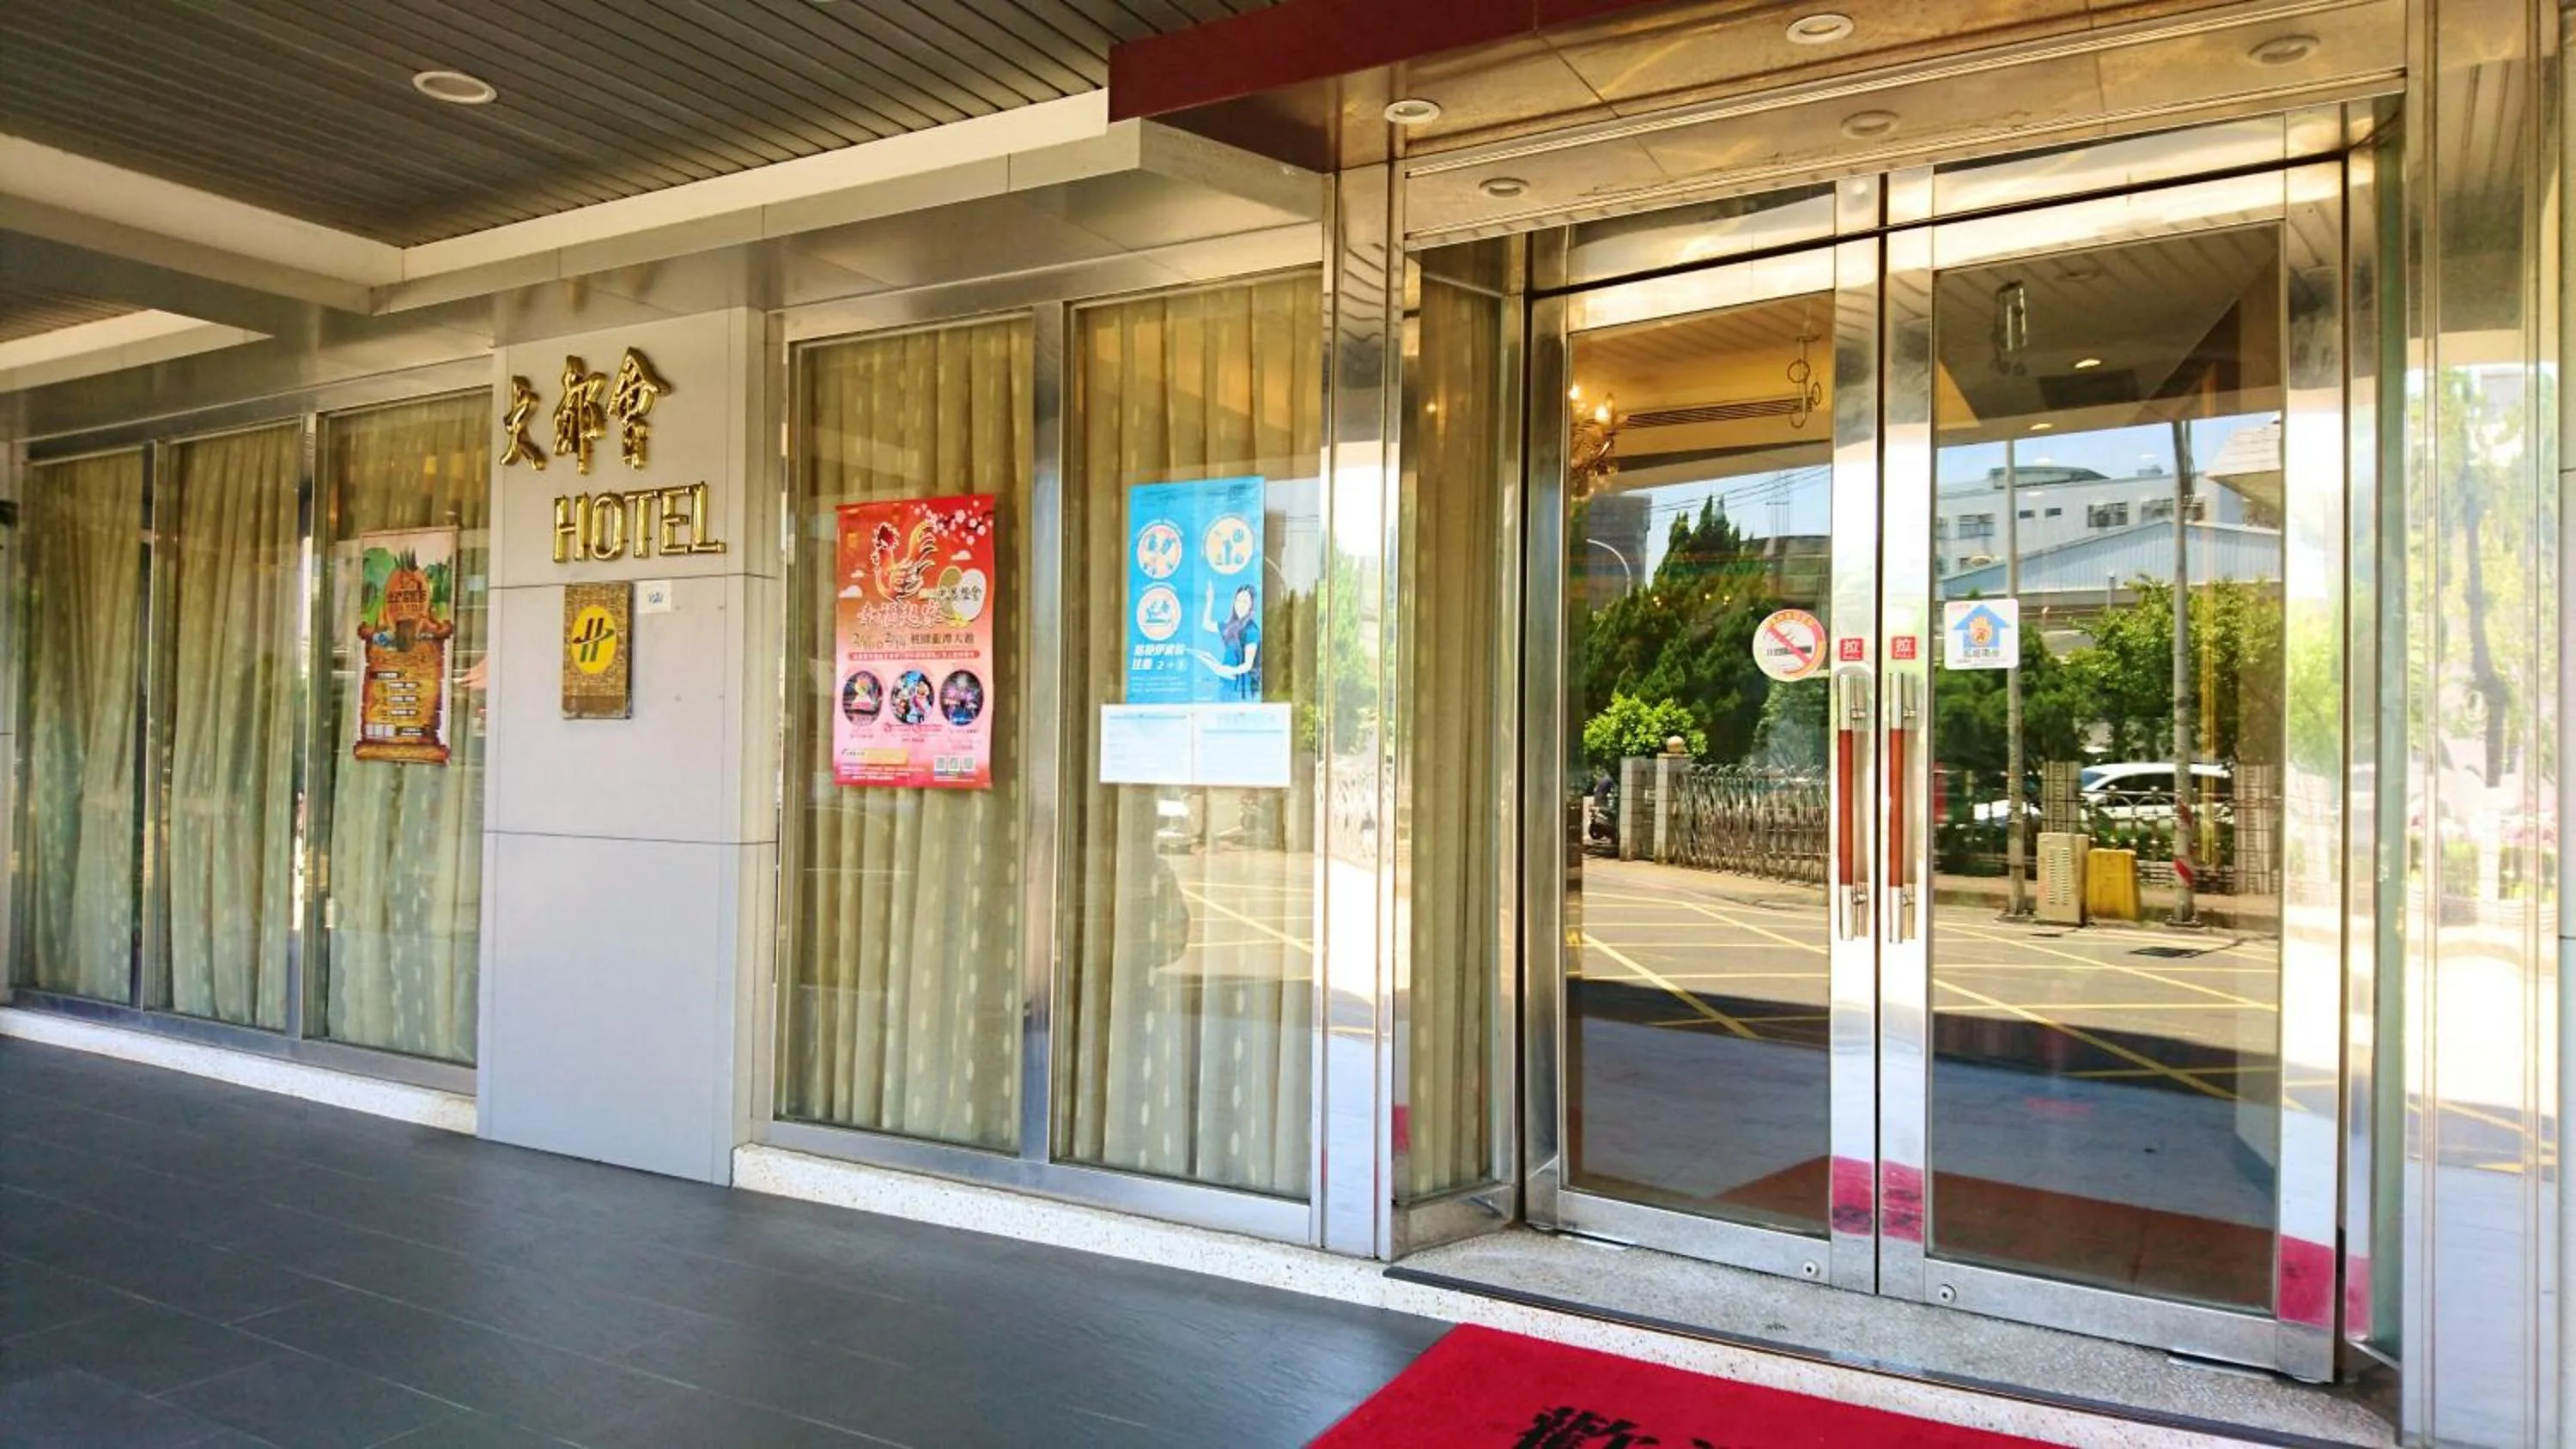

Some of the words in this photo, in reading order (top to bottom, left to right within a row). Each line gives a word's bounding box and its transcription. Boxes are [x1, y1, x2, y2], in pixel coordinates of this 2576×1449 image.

[501, 346, 675, 474] 大都會
[552, 481, 726, 563] HOTEL
[1843, 639, 1859, 652] 拉
[1895, 638, 1911, 652] 拉
